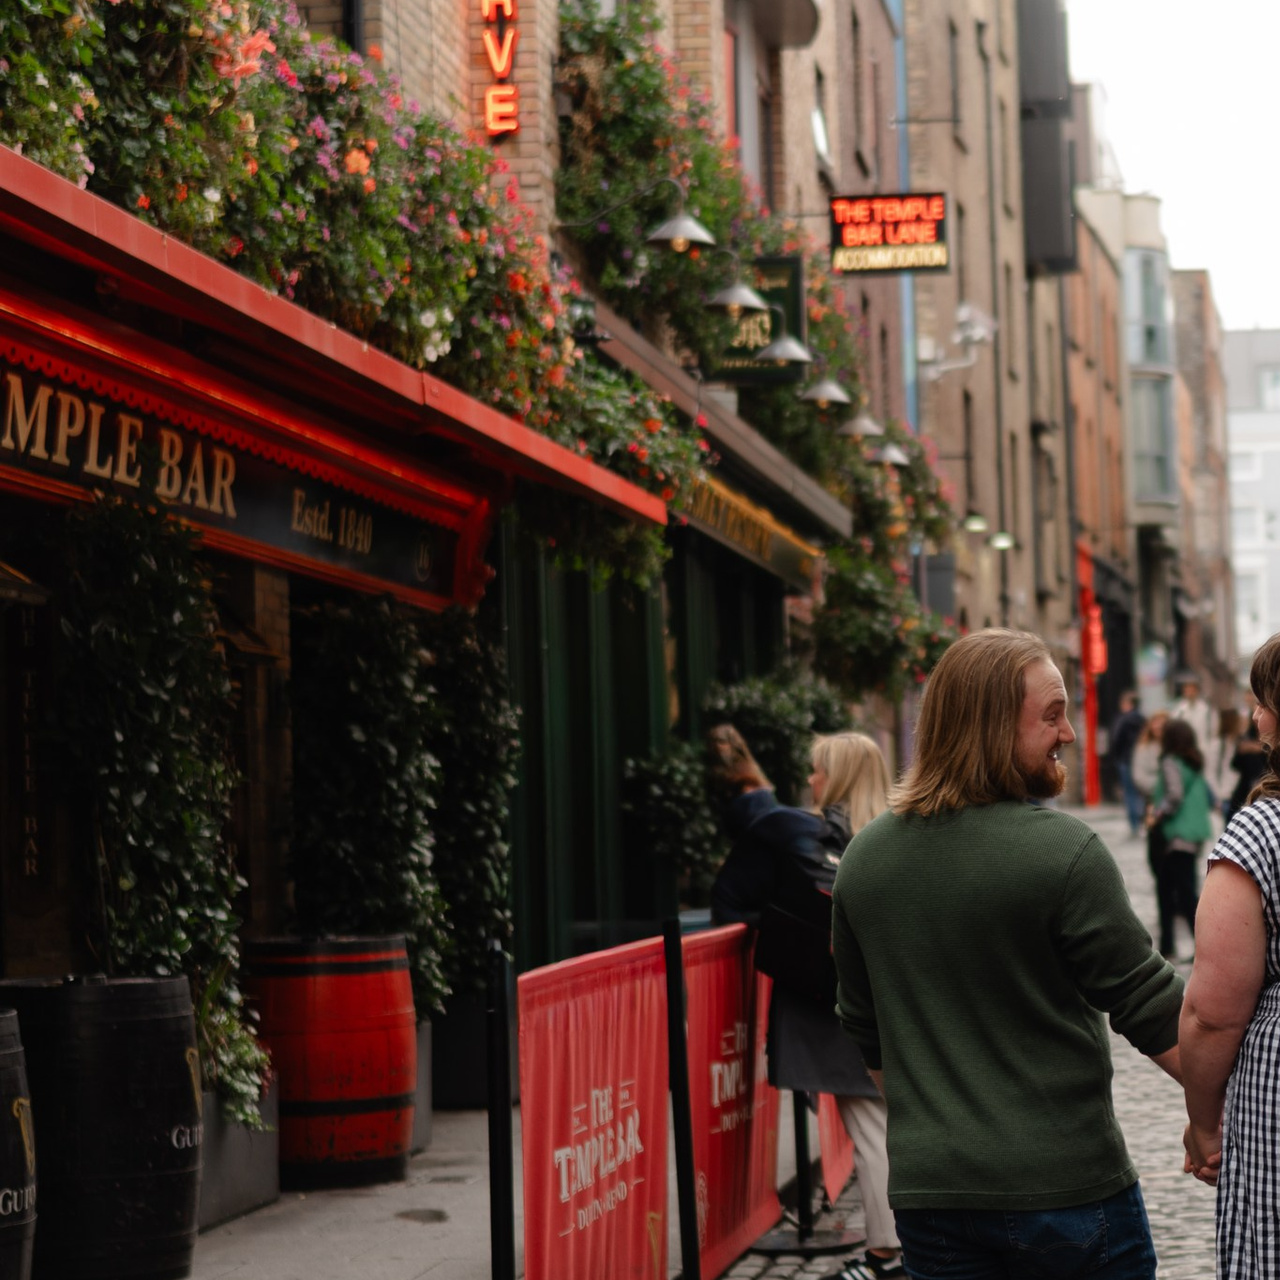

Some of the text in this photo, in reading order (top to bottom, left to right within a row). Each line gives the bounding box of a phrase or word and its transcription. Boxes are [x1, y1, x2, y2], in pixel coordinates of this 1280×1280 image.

[831, 195, 944, 224] THE TEMPLE
[842, 220, 937, 247] BAR LANE
[1, 372, 238, 519] MPLE BAR
[291, 487, 373, 555] Estd. 1840
[591, 1086, 614, 1128] THE
